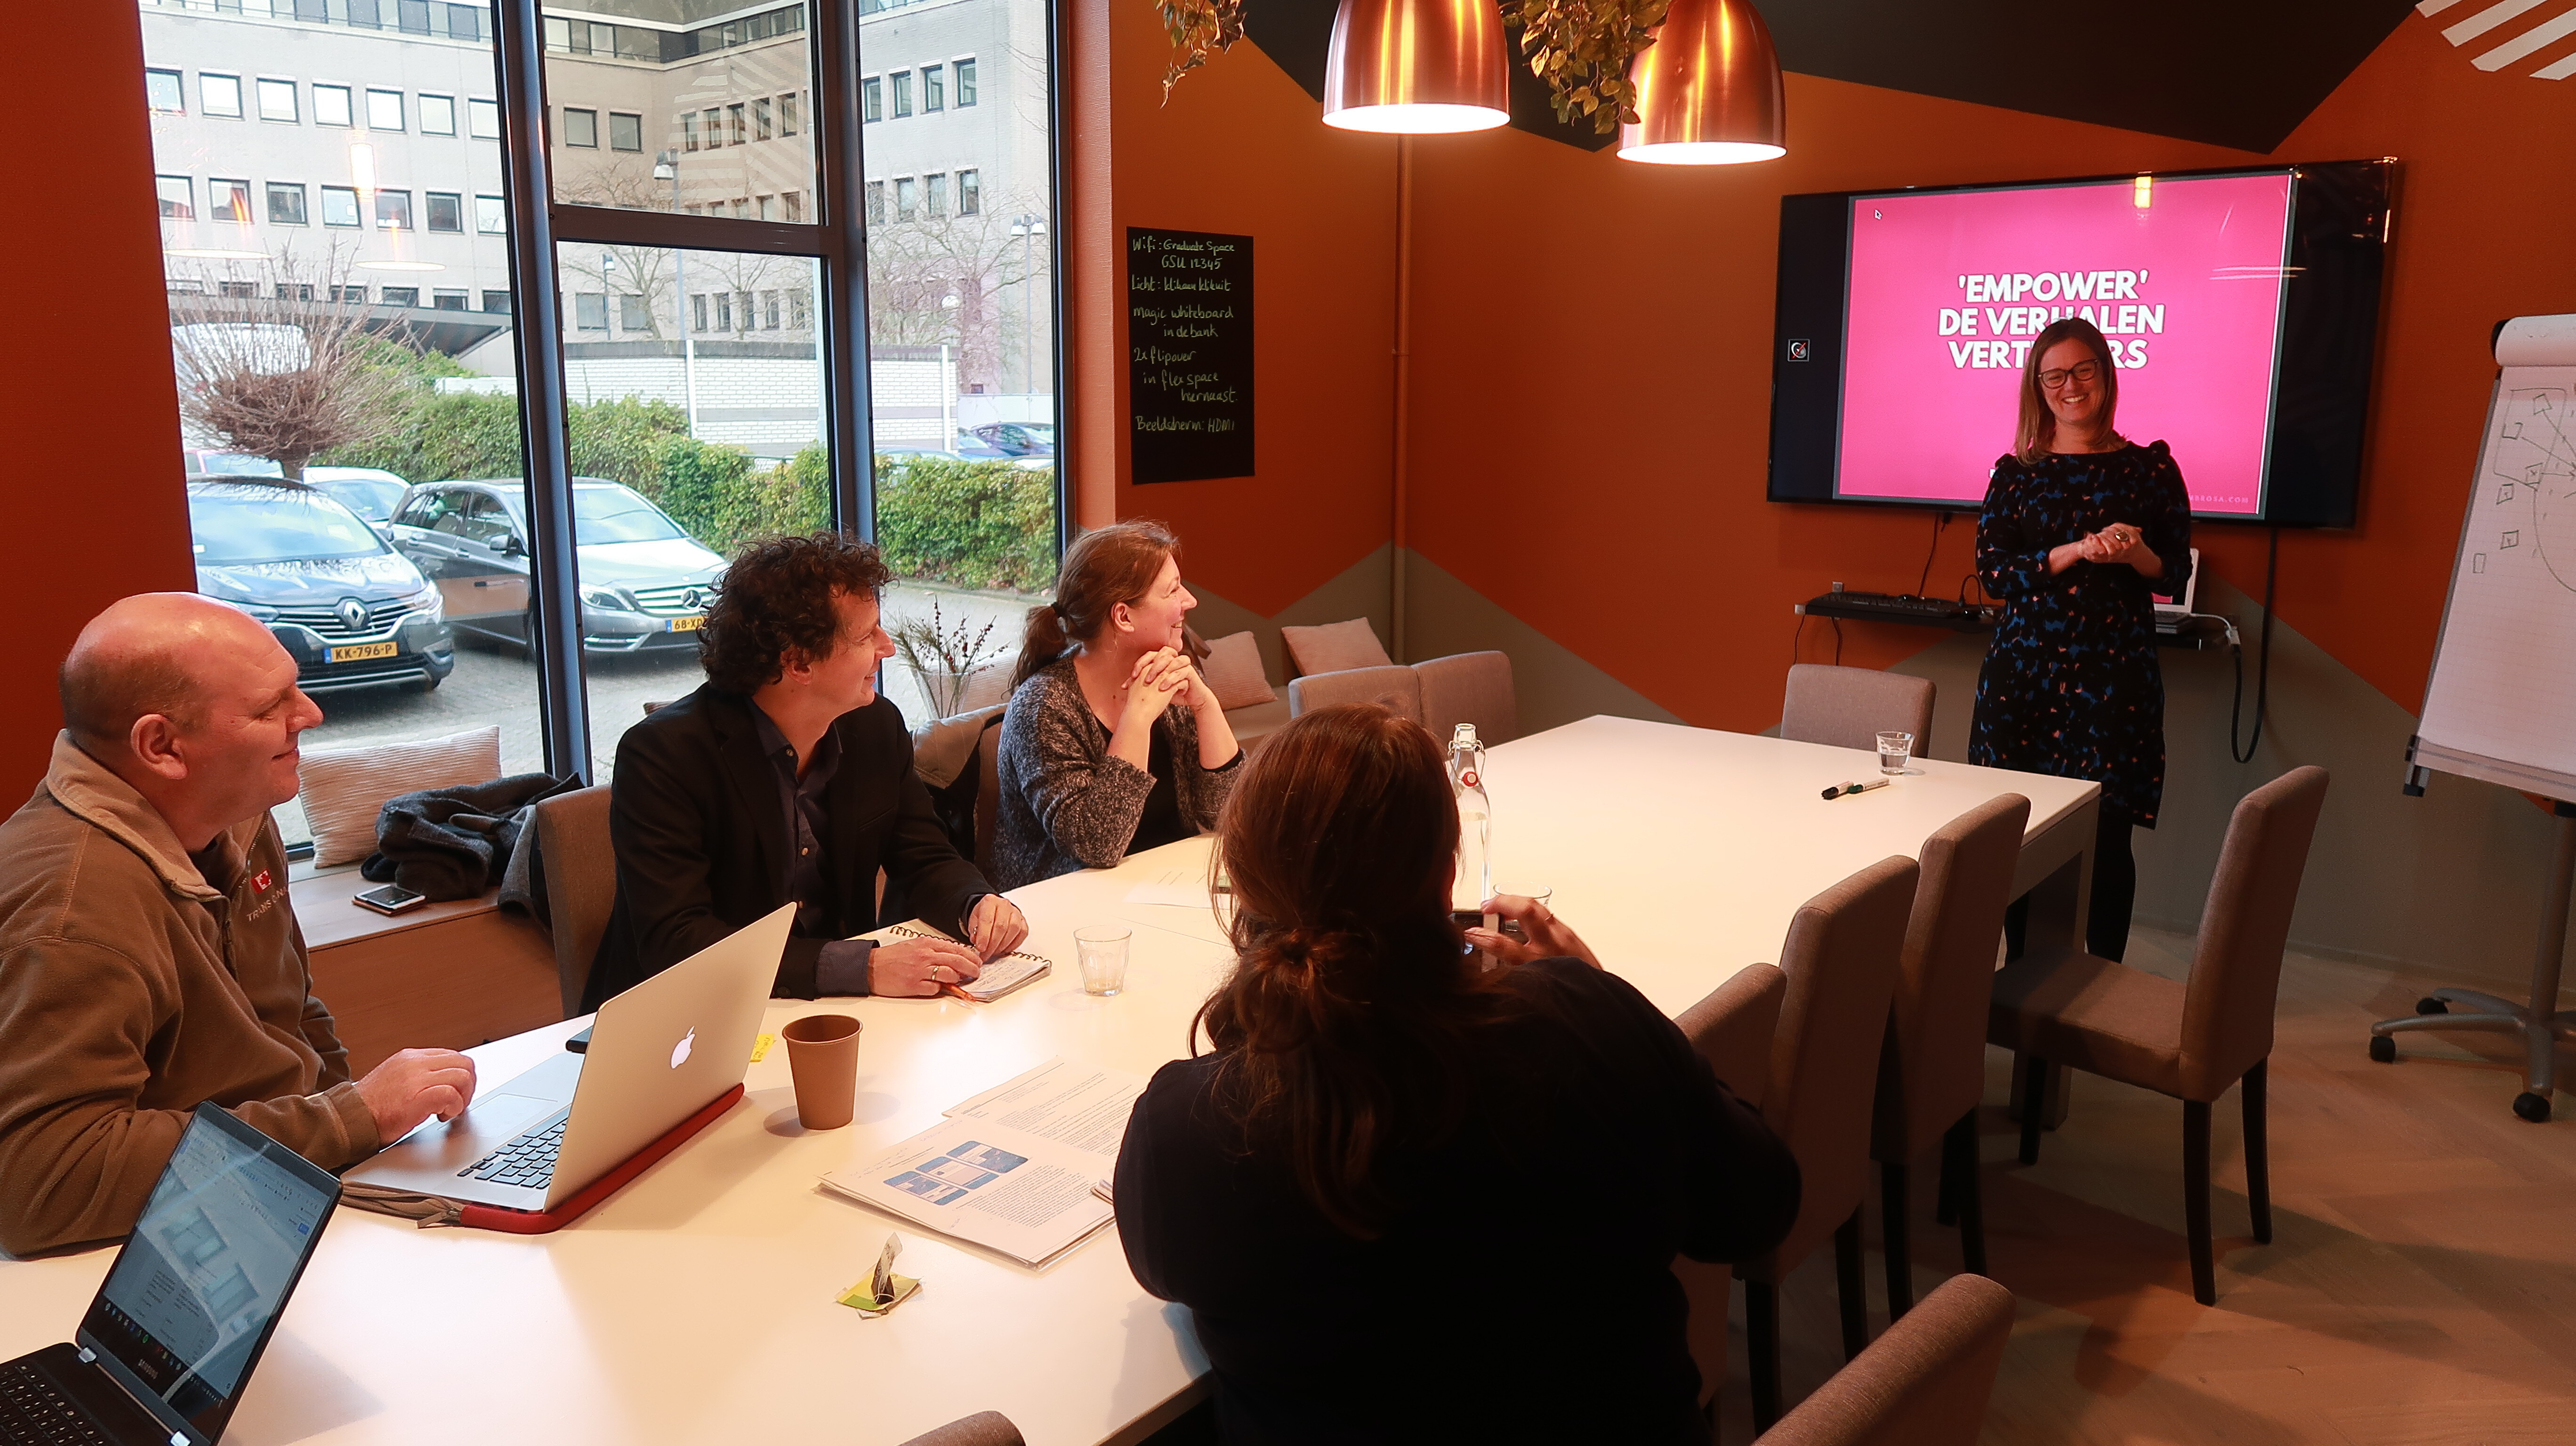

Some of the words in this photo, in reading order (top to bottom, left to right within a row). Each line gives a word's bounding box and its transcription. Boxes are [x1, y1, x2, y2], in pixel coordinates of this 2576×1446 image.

[1163, 239, 1205, 251] Graduate
[1206, 241, 1235, 256] Space
[1161, 255, 1186, 268] GSU
[1190, 257, 1223, 270] 12345
[1958, 269, 2149, 303] 'EMPOWER'
[1171, 304, 1234, 319] whiteboard
[1938, 307, 1980, 336] DE
[1163, 324, 1174, 337] in
[1176, 325, 1189, 337] de
[1190, 323, 1219, 337] bank
[1134, 347, 1148, 362] 2x
[1150, 345, 1197, 366] flipover
[1143, 372, 1156, 384] in
[1208, 417, 1235, 433] HDMI
[335, 644, 392, 660] KK-796-P
